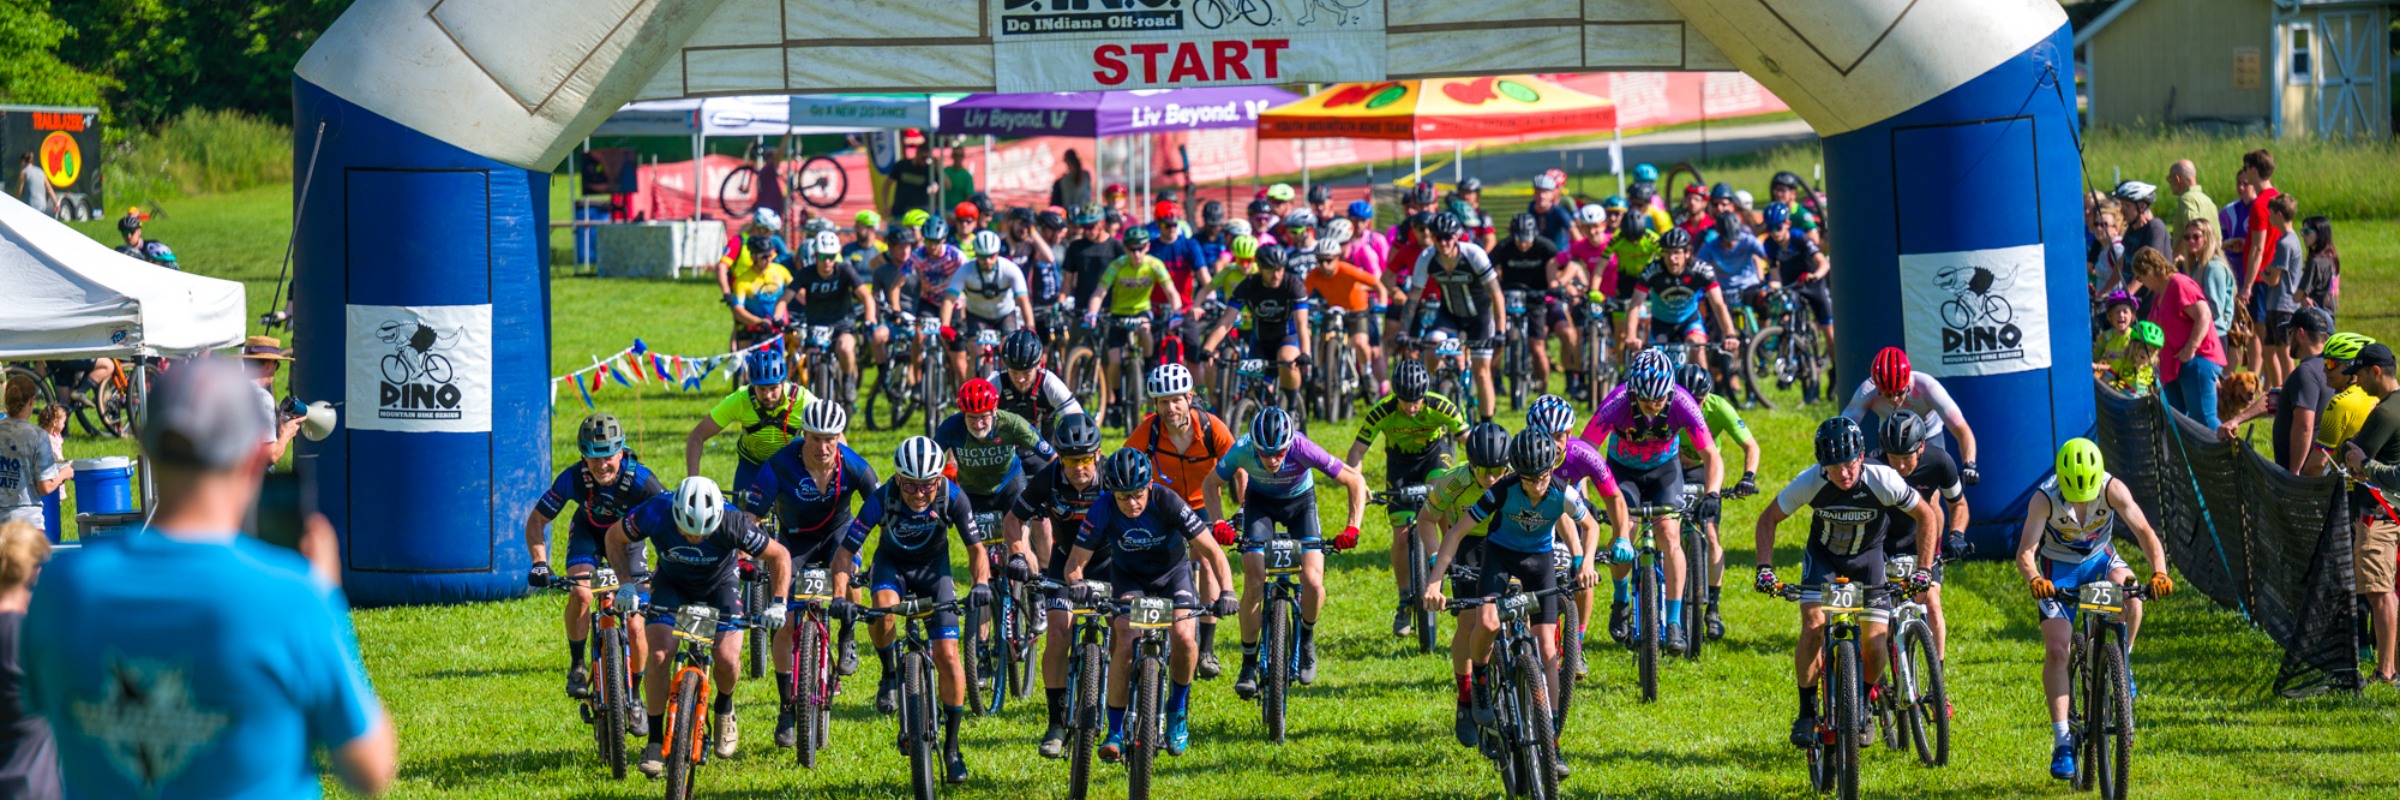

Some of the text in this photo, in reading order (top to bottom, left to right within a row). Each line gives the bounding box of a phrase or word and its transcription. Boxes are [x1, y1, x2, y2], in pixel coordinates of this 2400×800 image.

[1006, 19, 1030, 32] Do
[1107, 14, 1176, 28] Off-road
[1092, 39, 1290, 86] START
[964, 109, 1046, 130] Liv Beyond.
[1132, 101, 1240, 127] Liv Beyond.
[810, 280, 839, 293] FOX
[956, 444, 1012, 458] BICYCLE
[1818, 509, 1873, 522] TRAILHOUSE
[980, 523, 993, 540] 31
[1273, 549, 1293, 568] 23
[1895, 562, 1914, 578] 37
[600, 575, 619, 587] 28
[804, 578, 824, 594] 29
[1831, 590, 1853, 608] 20
[2091, 587, 2112, 605] 25
[691, 615, 703, 634] 7
[1142, 608, 1160, 624] 19
